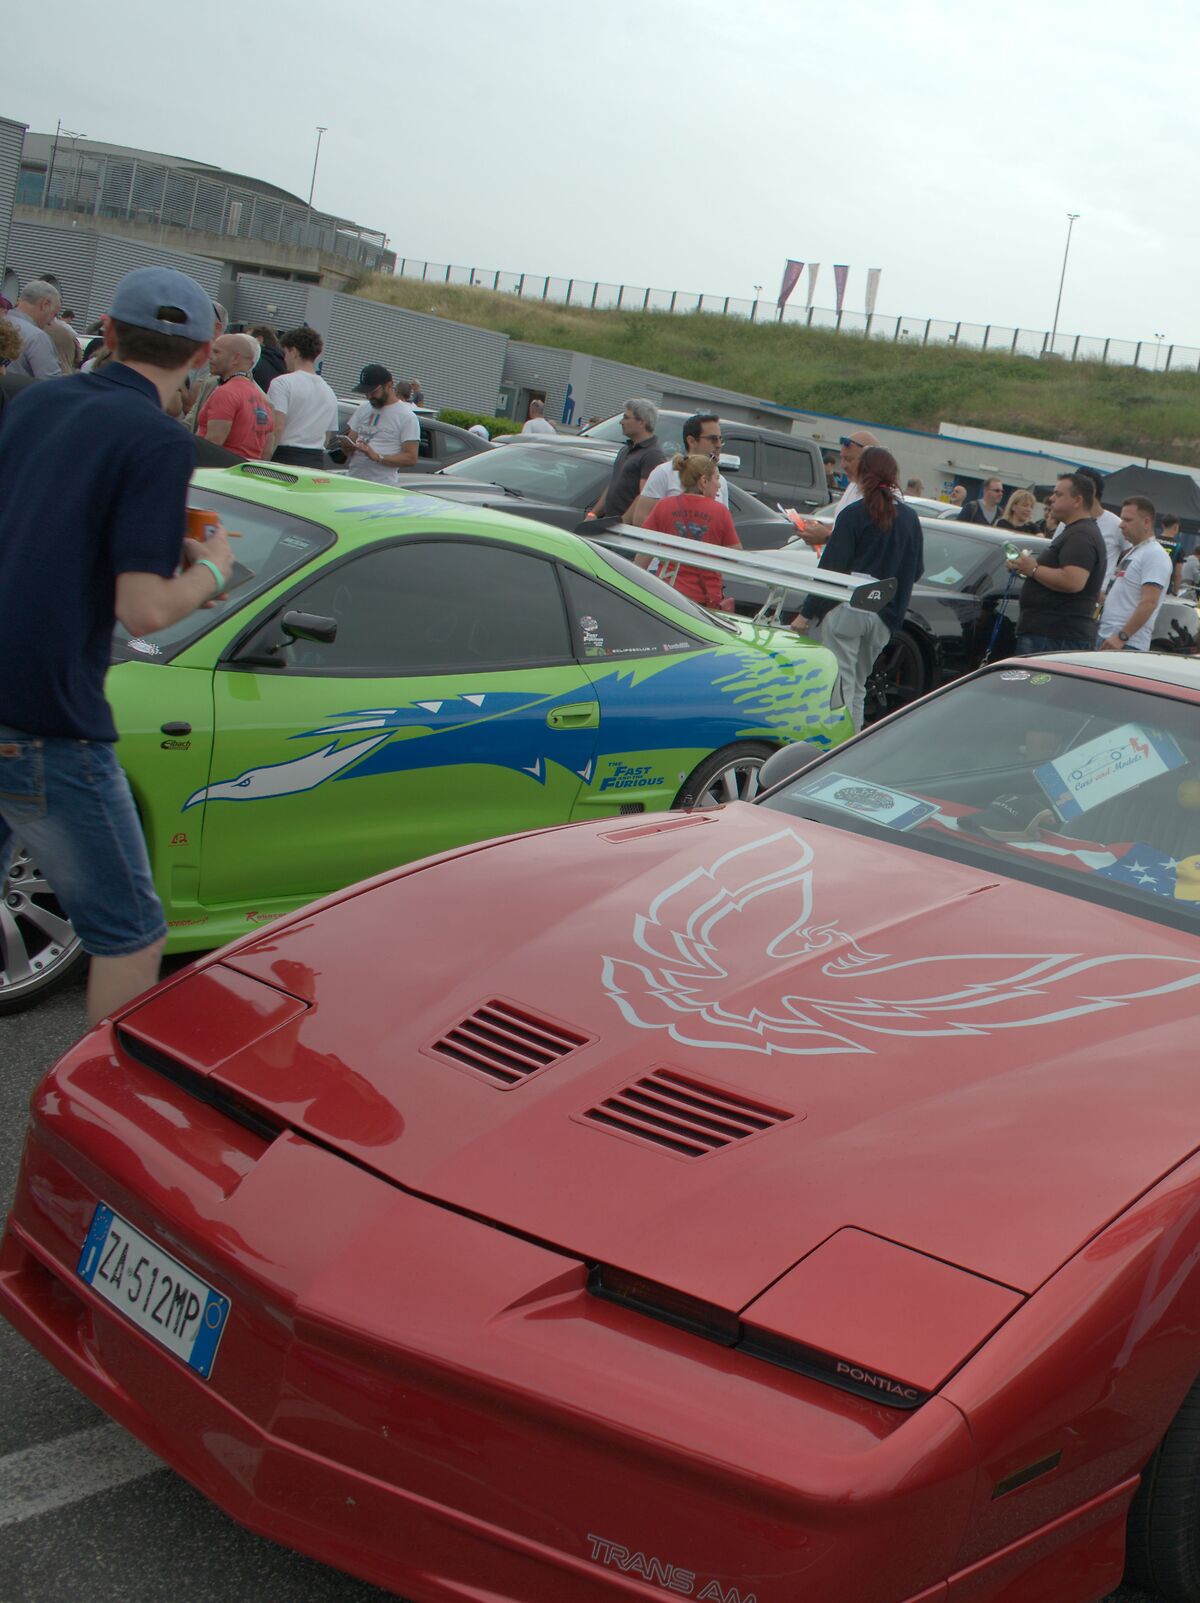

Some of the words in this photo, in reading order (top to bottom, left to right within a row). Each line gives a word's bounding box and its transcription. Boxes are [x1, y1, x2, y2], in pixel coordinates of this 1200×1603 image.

[599, 777, 664, 791] FURIOUS
[614, 766, 652, 777] FAST
[1074, 777, 1094, 792] Cars
[1095, 768, 1111, 782] and
[1113, 754, 1142, 774] Models
[98, 1230, 130, 1290] ZA
[128, 1256, 201, 1339] 512MP
[836, 1361, 918, 1400] PONTIAC
[587, 1533, 696, 1595] TRANS
